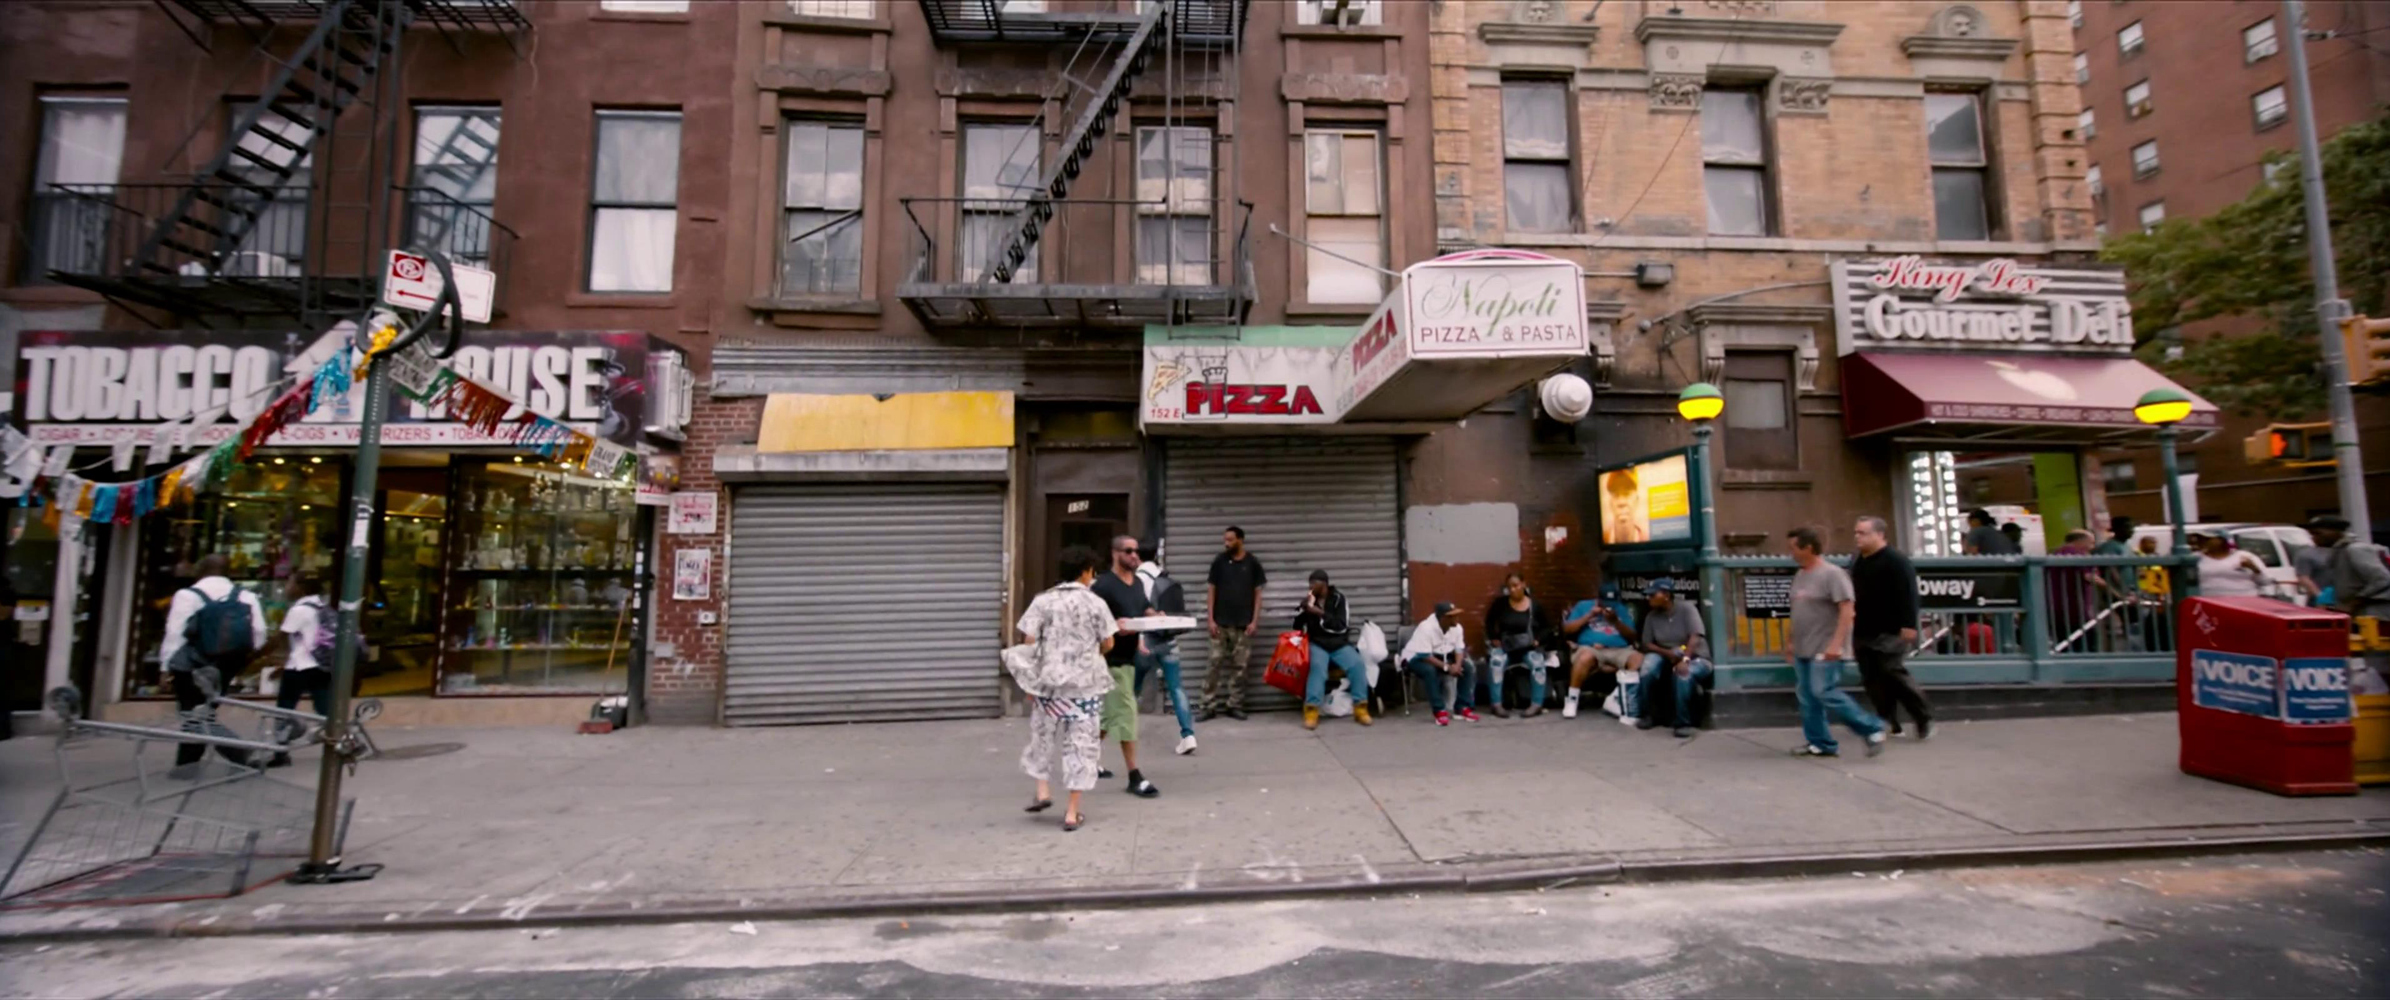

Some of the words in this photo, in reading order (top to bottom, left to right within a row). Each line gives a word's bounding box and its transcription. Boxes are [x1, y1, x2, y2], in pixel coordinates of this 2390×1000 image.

[1874, 255, 1972, 299] King
[1977, 258, 2046, 294] Lex
[1422, 272, 1562, 337] Napoli
[1864, 294, 2037, 340] Gourmet
[2050, 299, 2136, 344] Deli
[1353, 308, 1397, 375] PIZZA
[1421, 326, 1480, 343] PIZZA
[1502, 325, 1514, 341] &
[1521, 324, 1577, 341] PASTA
[21, 345, 271, 420] TOBACCO
[409, 343, 604, 420] OUSE
[1186, 380, 1325, 416] PIZZA
[1151, 408, 1170, 419] 152
[1174, 408, 1181, 419] E
[281, 427, 326, 441] E-CIGS
[345, 427, 432, 441] VARIZERS
[1915, 575, 1975, 599] bway
[2200, 658, 2275, 690] VOICE
[2288, 667, 2349, 691] VOICE
